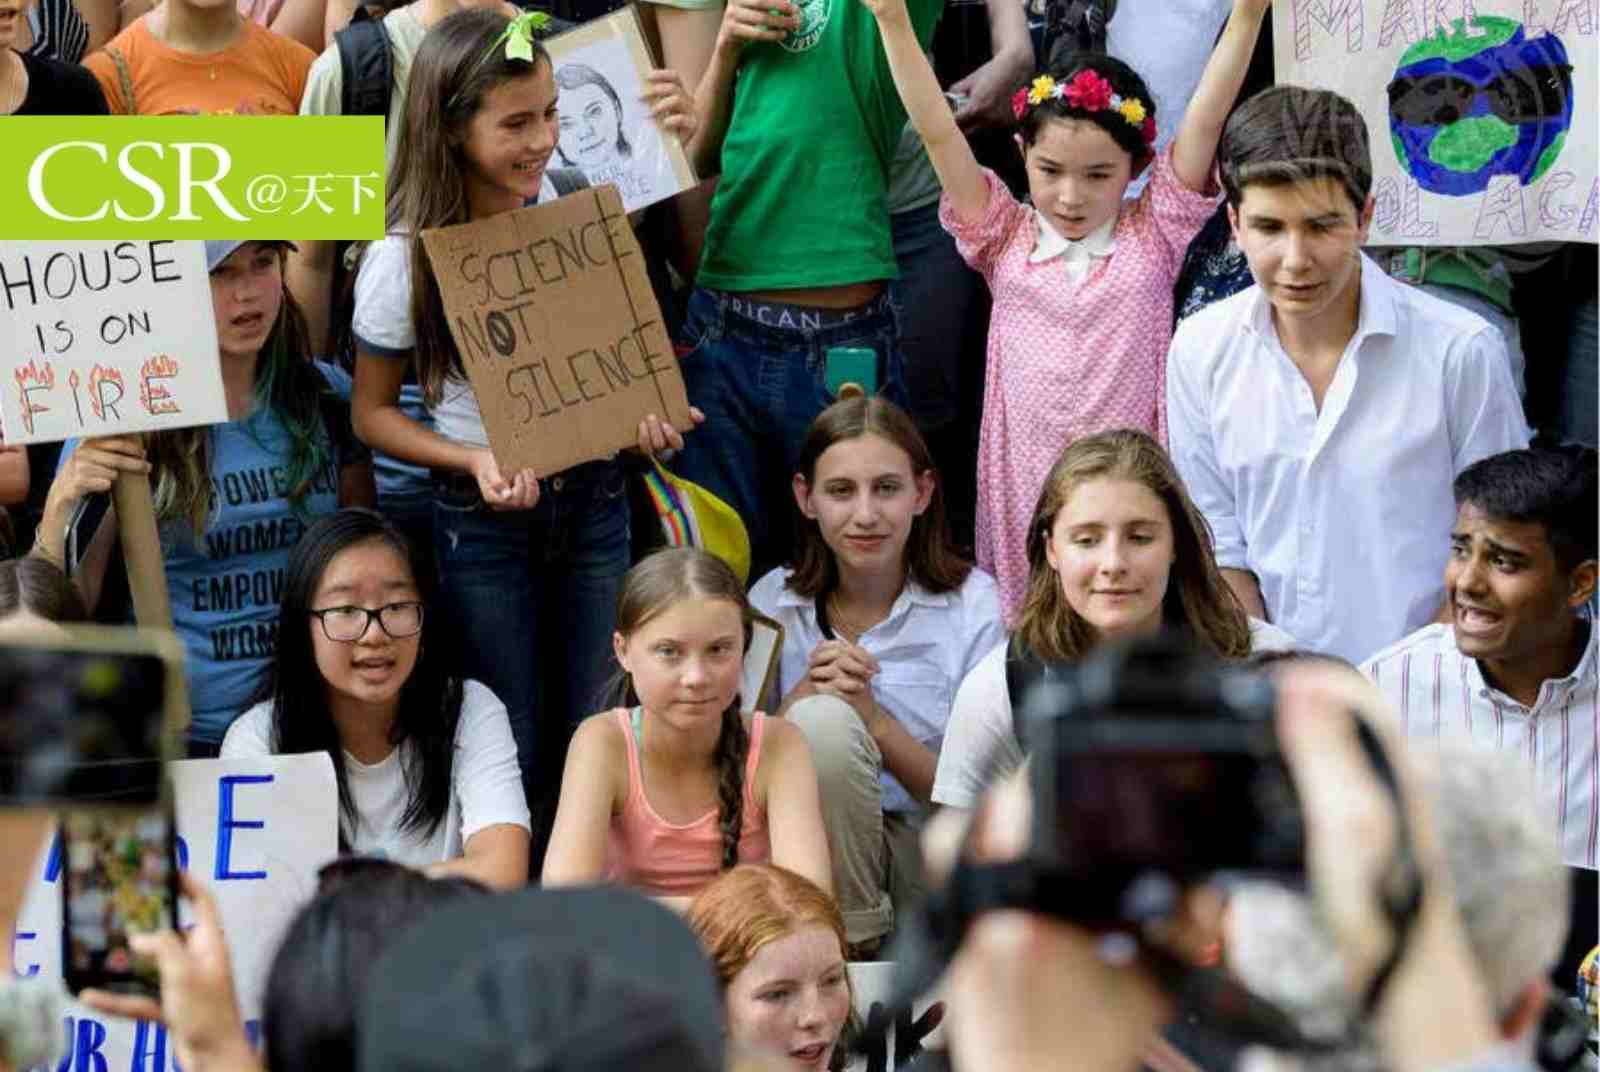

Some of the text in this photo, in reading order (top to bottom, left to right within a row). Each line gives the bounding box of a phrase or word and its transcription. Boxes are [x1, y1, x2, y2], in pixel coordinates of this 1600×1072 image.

[0, 239, 182, 310] HOUSE
[459, 212, 634, 306] SCIENCE
[36, 311, 151, 354] IS ON
[456, 300, 535, 364] NOT
[14, 356, 182, 435] FIRE
[505, 319, 673, 425] SILENCE
